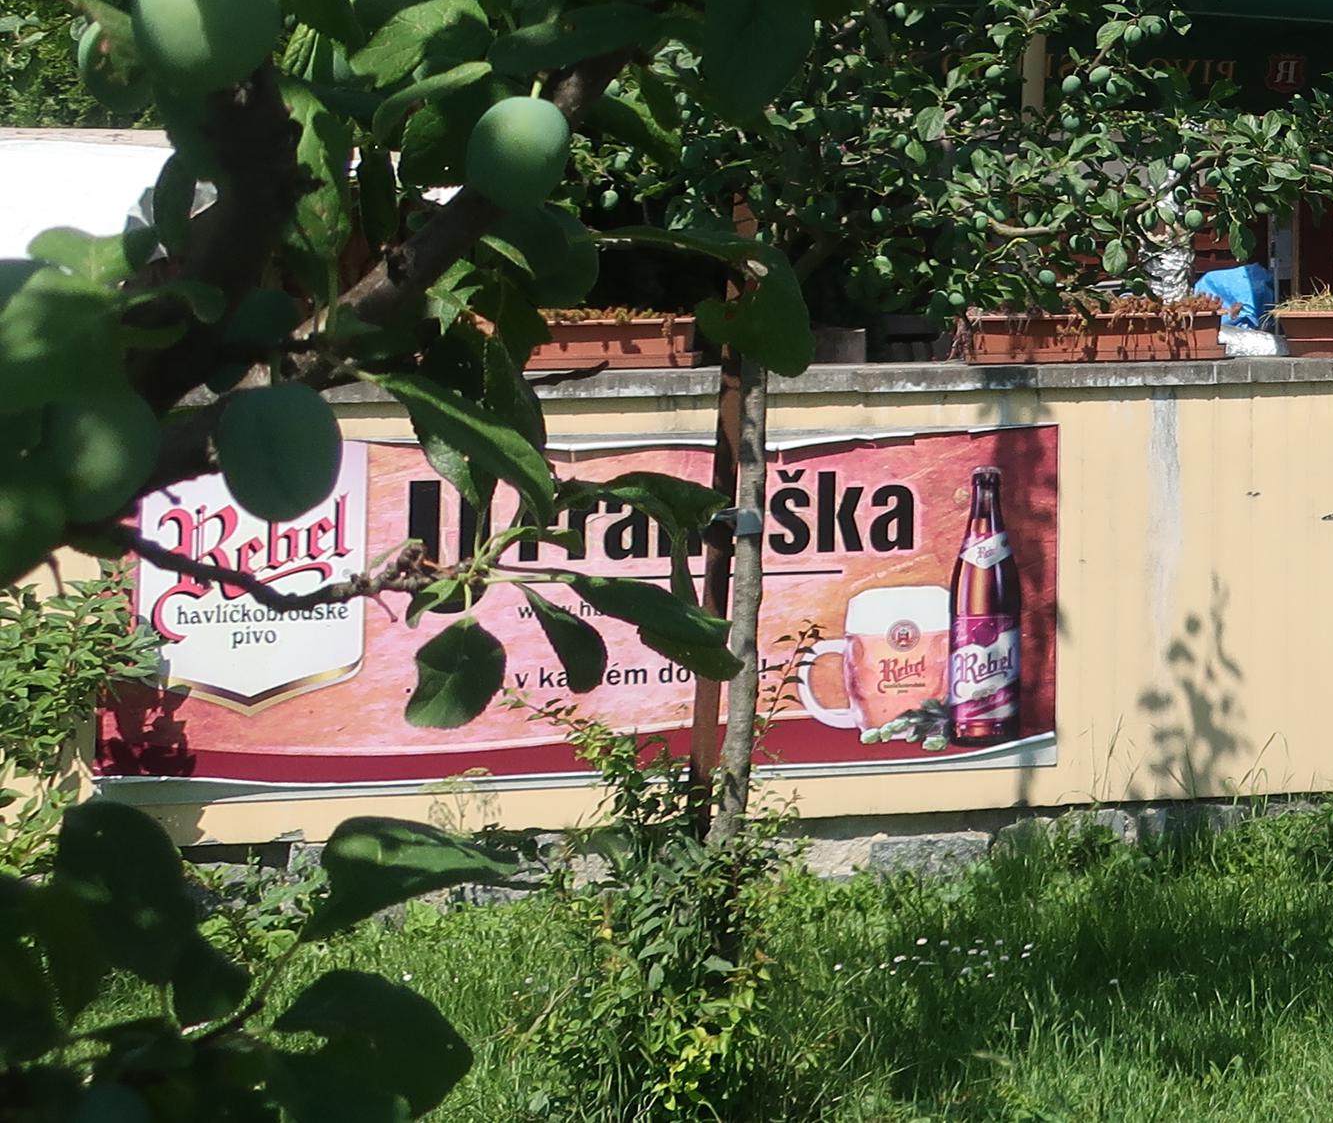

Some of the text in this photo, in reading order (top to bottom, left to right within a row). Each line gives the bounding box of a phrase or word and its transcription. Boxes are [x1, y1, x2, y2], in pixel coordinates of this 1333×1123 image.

[151, 491, 354, 644] Rebel
[231, 626, 278, 649] pivo
[515, 673, 529, 688] v
[539, 662, 648, 689] kaém
[878, 654, 926, 693] Rebel
[953, 647, 1013, 698] Rebel
